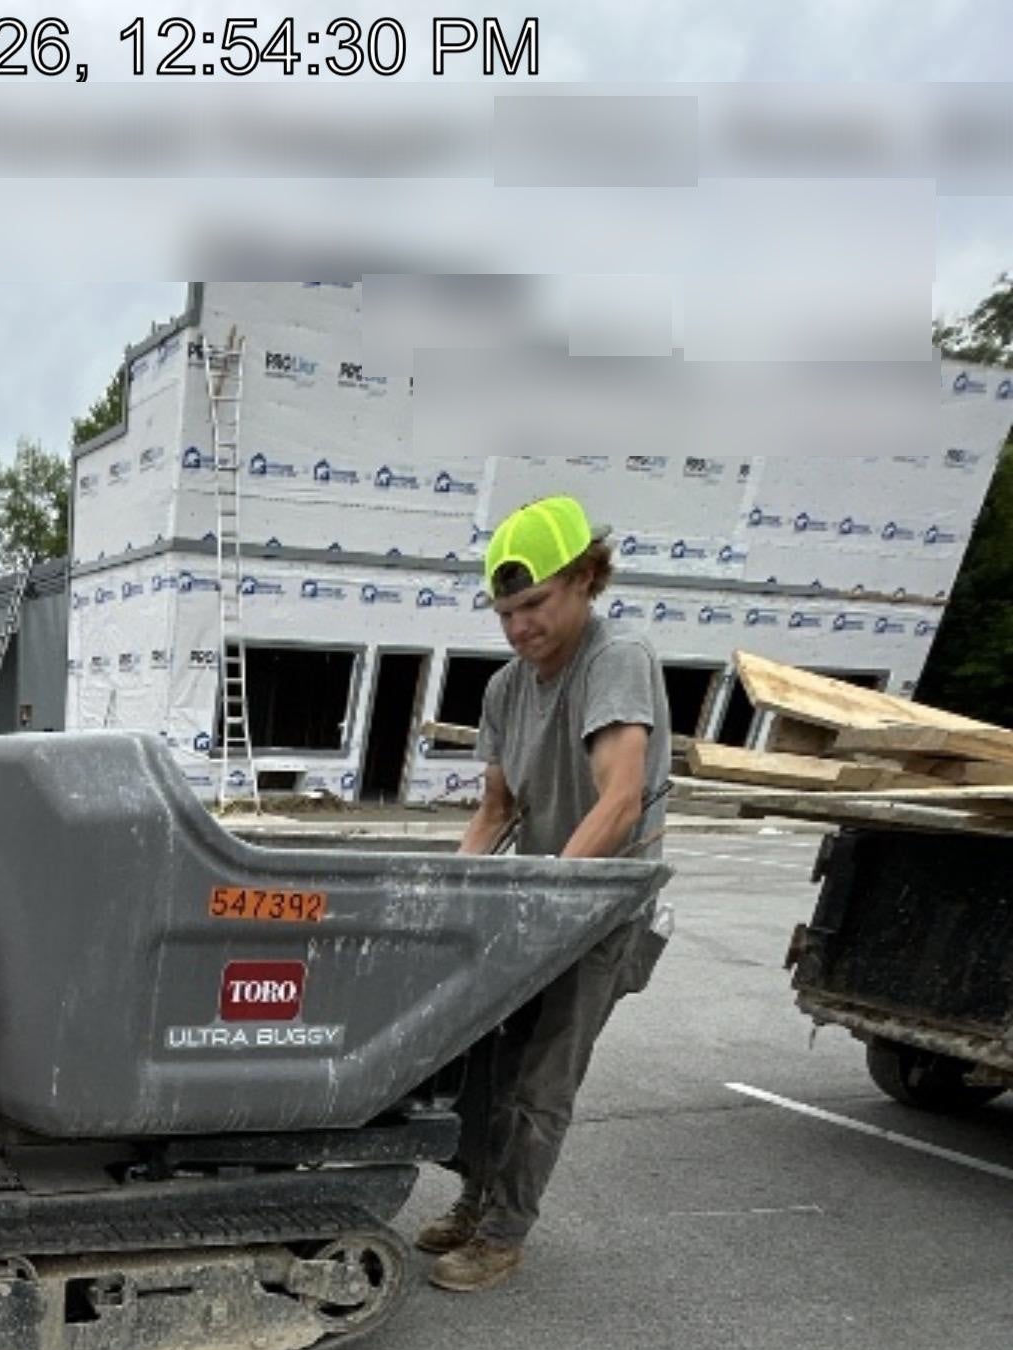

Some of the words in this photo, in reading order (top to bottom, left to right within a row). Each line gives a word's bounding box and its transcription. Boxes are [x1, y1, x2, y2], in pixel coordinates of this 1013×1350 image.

[211, 889, 322, 922] 547392
[228, 980, 297, 1003] TORO
[168, 1029, 249, 1048] ULTRA
[256, 1027, 340, 1045] BUGGY
